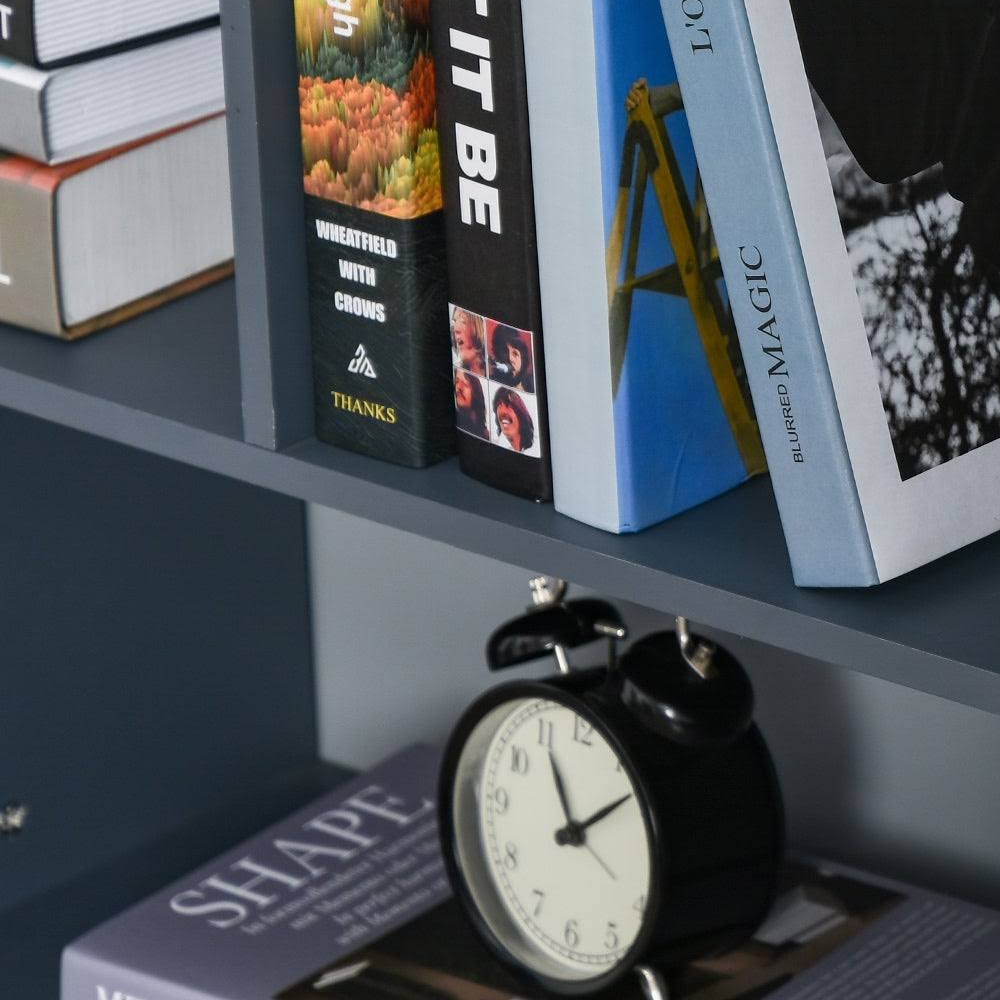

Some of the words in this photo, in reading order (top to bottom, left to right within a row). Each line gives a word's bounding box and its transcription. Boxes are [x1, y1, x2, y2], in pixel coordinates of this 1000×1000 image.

[449, 27, 494, 112] IT
[455, 122, 502, 234] BE
[315, 218, 397, 259] WHEATFIELD
[338, 258, 377, 287] WITH
[334, 291, 386, 323] CROWS
[738, 244, 789, 379] MAGIC
[331, 390, 397, 424] THANKS
[777, 383, 804, 463] BLURRED
[169, 785, 435, 929] SHAPE
